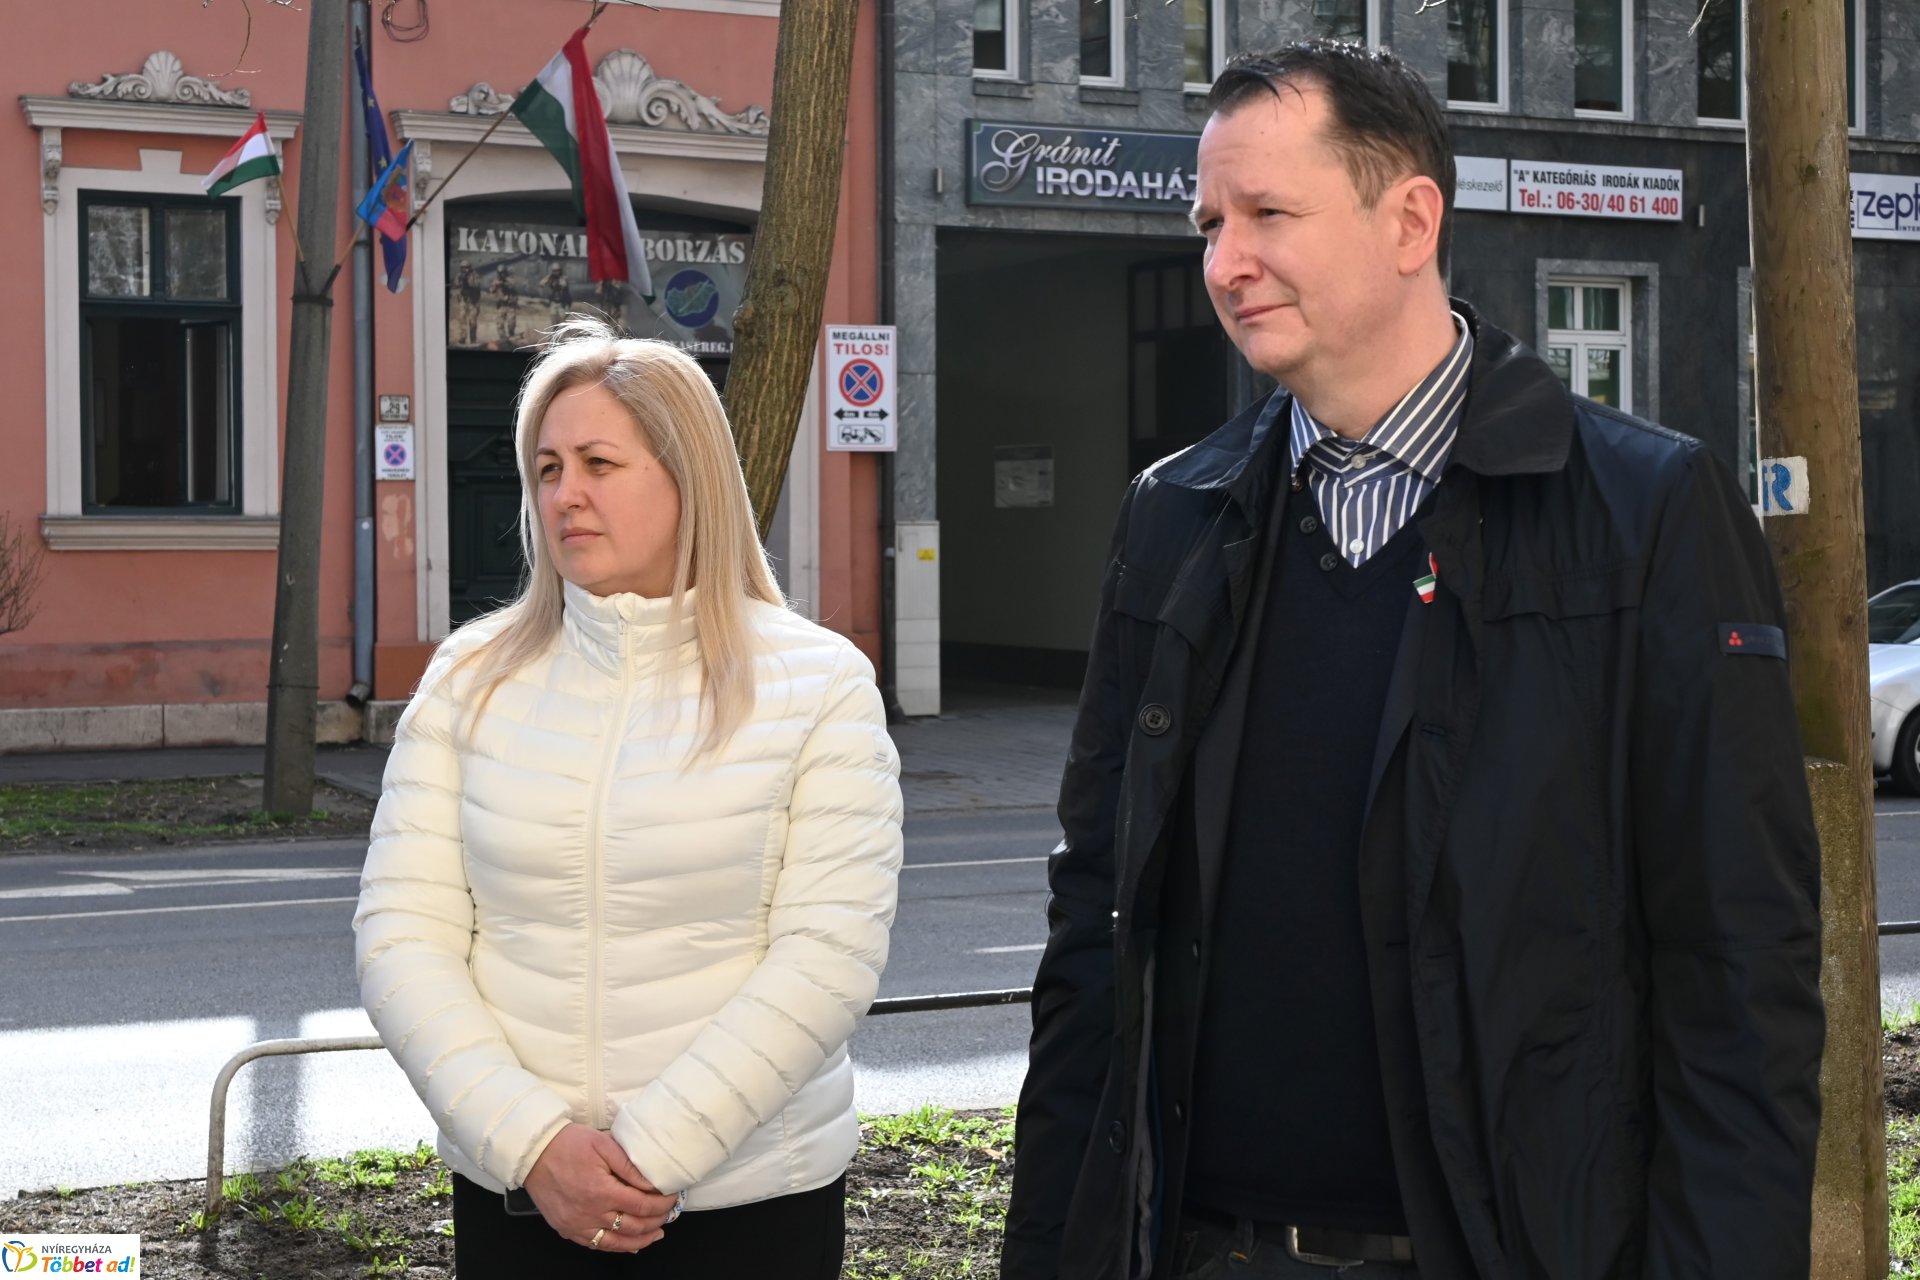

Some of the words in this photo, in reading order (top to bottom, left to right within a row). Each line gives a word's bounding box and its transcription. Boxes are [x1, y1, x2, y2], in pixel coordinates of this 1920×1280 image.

[980, 129, 1122, 192] Gránit
[1532, 169, 1597, 187] KATEGÓRIÁS
[1602, 172, 1640, 189] IRODÁK
[1643, 174, 1680, 191] KIADÓK
[1519, 188, 1552, 208] Tel.:
[1629, 196, 1646, 214] 61
[1651, 197, 1679, 215] 400
[1857, 183, 1920, 231] zept
[640, 235, 746, 264] BORZÁS
[834, 343, 889, 356] TILOS!
